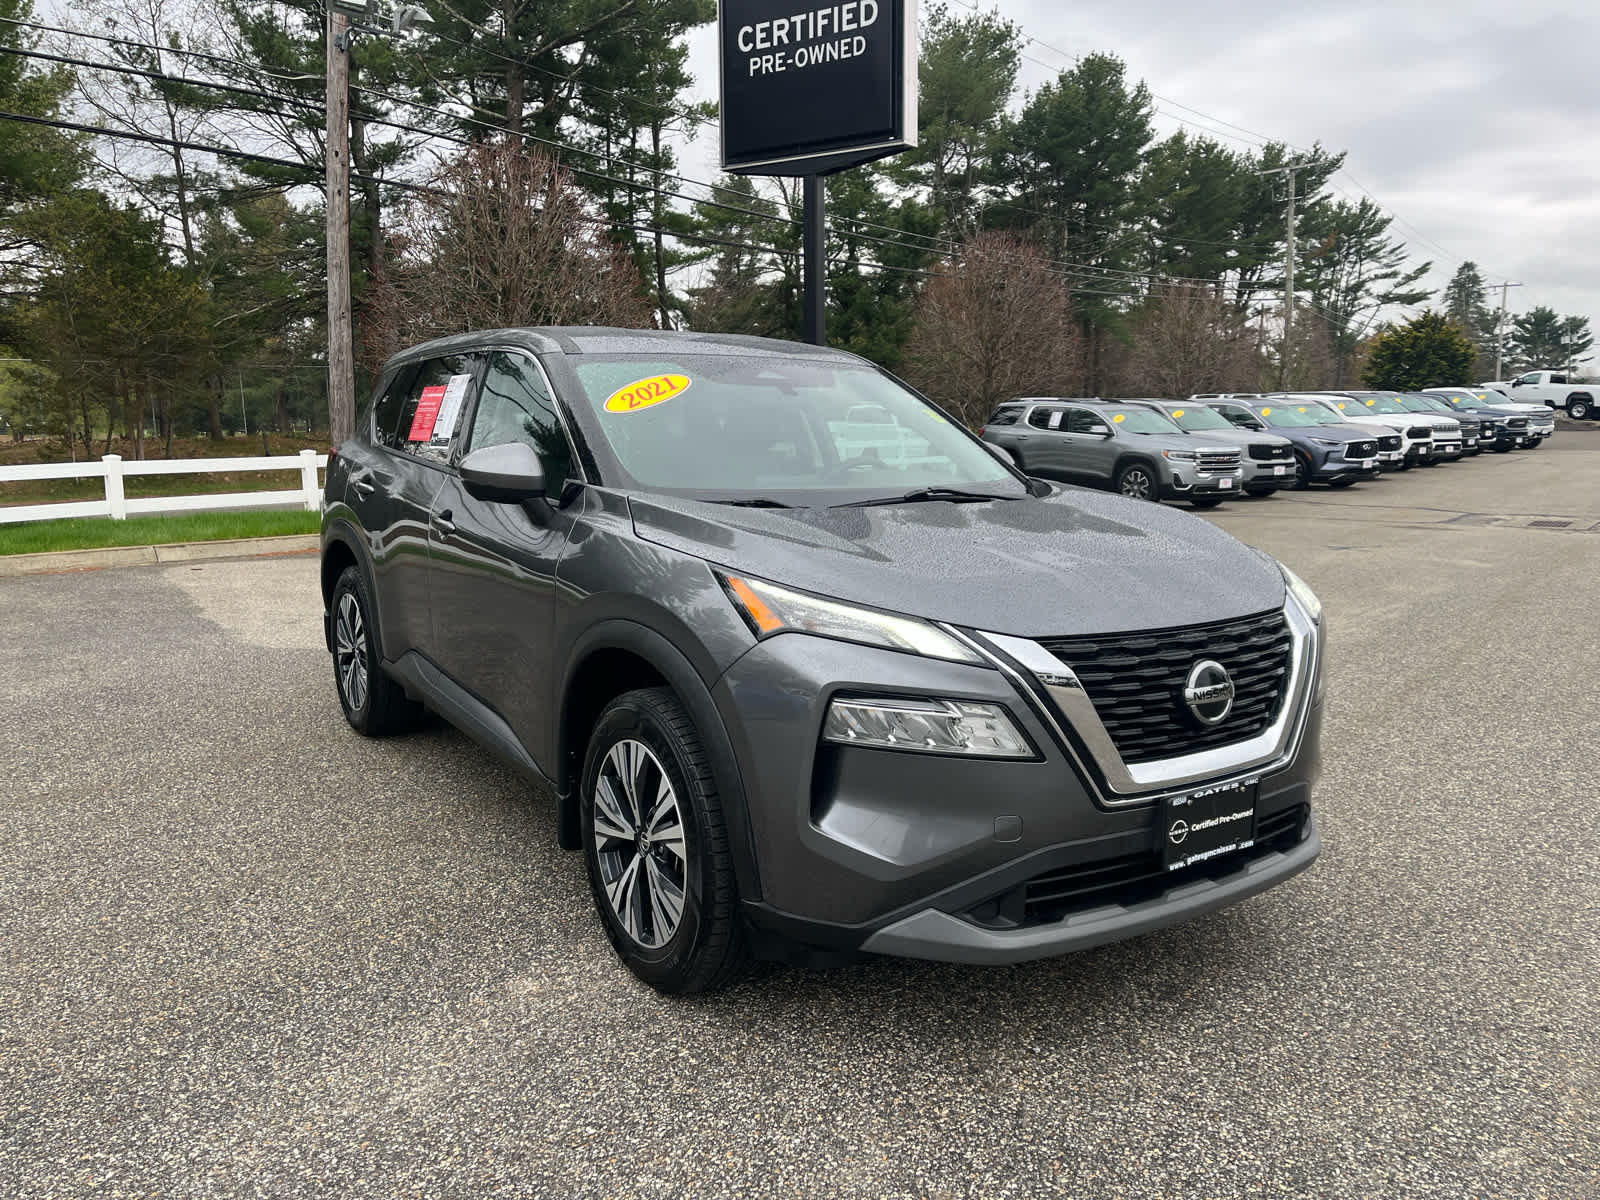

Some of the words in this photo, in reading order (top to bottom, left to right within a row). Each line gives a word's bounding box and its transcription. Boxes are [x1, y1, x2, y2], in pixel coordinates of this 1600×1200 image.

[737, 0, 879, 53] CERTIFIED
[749, 35, 867, 77] PRE-OWNED
[620, 376, 680, 409] 2021
[1191, 816, 1219, 832] Certified
[1219, 807, 1254, 824] Pre-Owned
